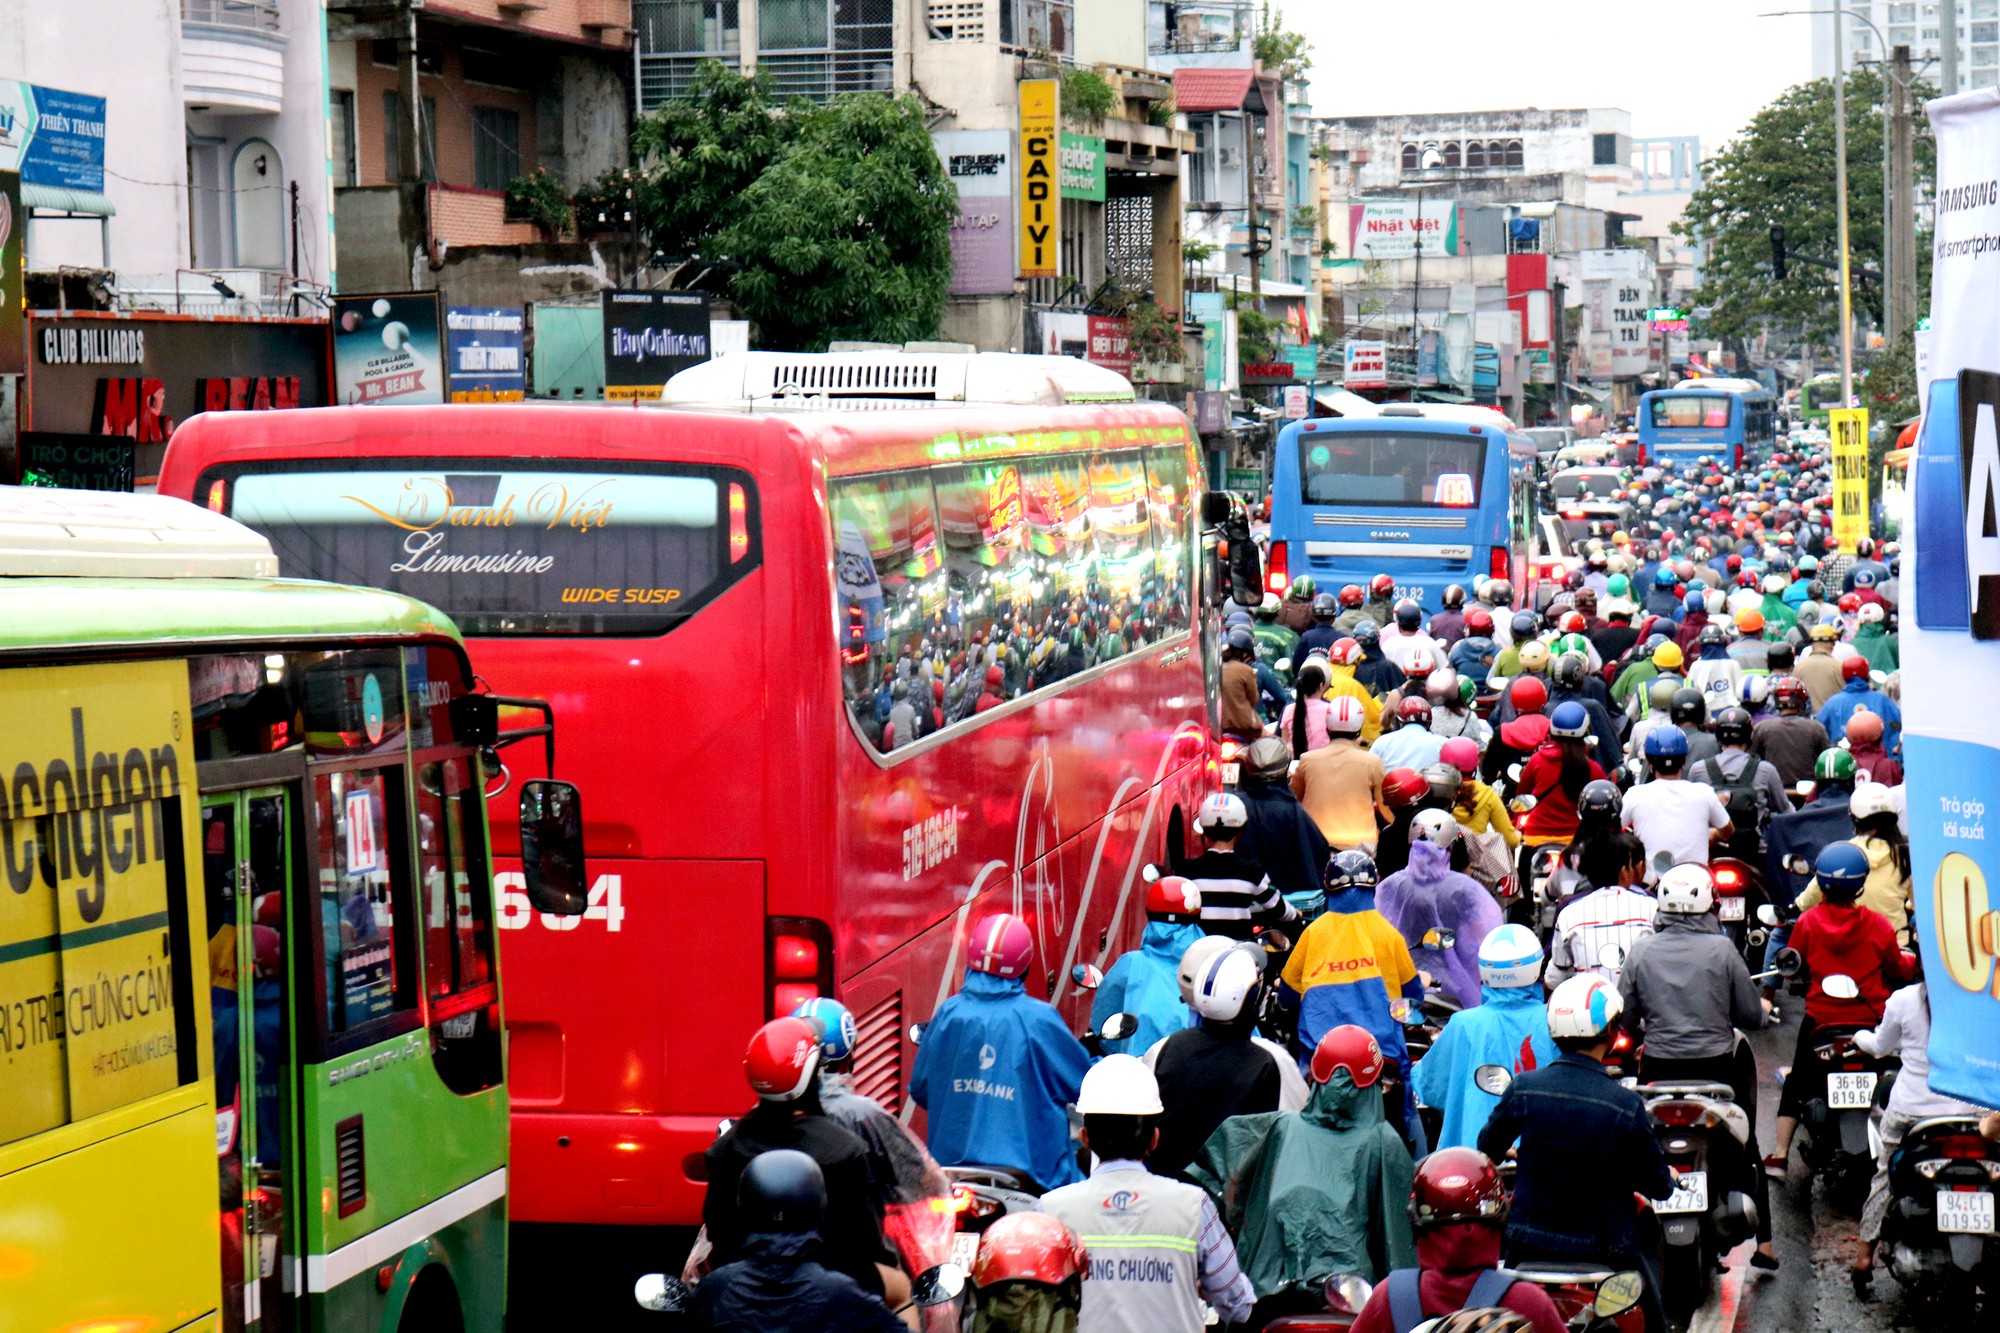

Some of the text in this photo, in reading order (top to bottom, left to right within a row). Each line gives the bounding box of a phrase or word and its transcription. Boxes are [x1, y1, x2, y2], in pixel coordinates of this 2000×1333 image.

[41, 112, 104, 138] THIÊN THANH
[949, 154, 1005, 166] MITSUBISHI
[949, 165, 998, 176] ELECTRIC
[1027, 137, 1049, 266] CADIVI
[1940, 180, 1998, 216] SAMSUNG
[1367, 217, 1440, 236] Nhật Việt
[1947, 233, 2000, 260] smartpho
[1619, 285, 1640, 302] ĐÈN
[1614, 308, 1648, 322] TRANG
[612, 326, 706, 363] iBuyOnline.vn
[1621, 324, 1639, 342] TRÍ
[44, 328, 144, 364] CLUB BILLIARDS
[385, 375, 415, 394] BEAN
[1837, 413, 1861, 445] THỜI
[1835, 455, 1866, 480] TRANG
[527, 477, 618, 534] Việt
[1370, 531, 1410, 540] SAMCO
[390, 530, 554, 575] Limousine
[561, 587, 681, 605] WIDE SUSP
[1939, 796, 1985, 819] Trả góp
[348, 798, 373, 866] 14
[1943, 821, 1985, 841] lãi suất
[1328, 956, 1378, 972] HON
[68, 954, 174, 1036] CHỨNG CẢM
[1836, 1075, 1870, 1089] 36-B6
[1941, 1213, 1991, 1230] 019.55
[1118, 1255, 1174, 1284] CHƯƠNG
